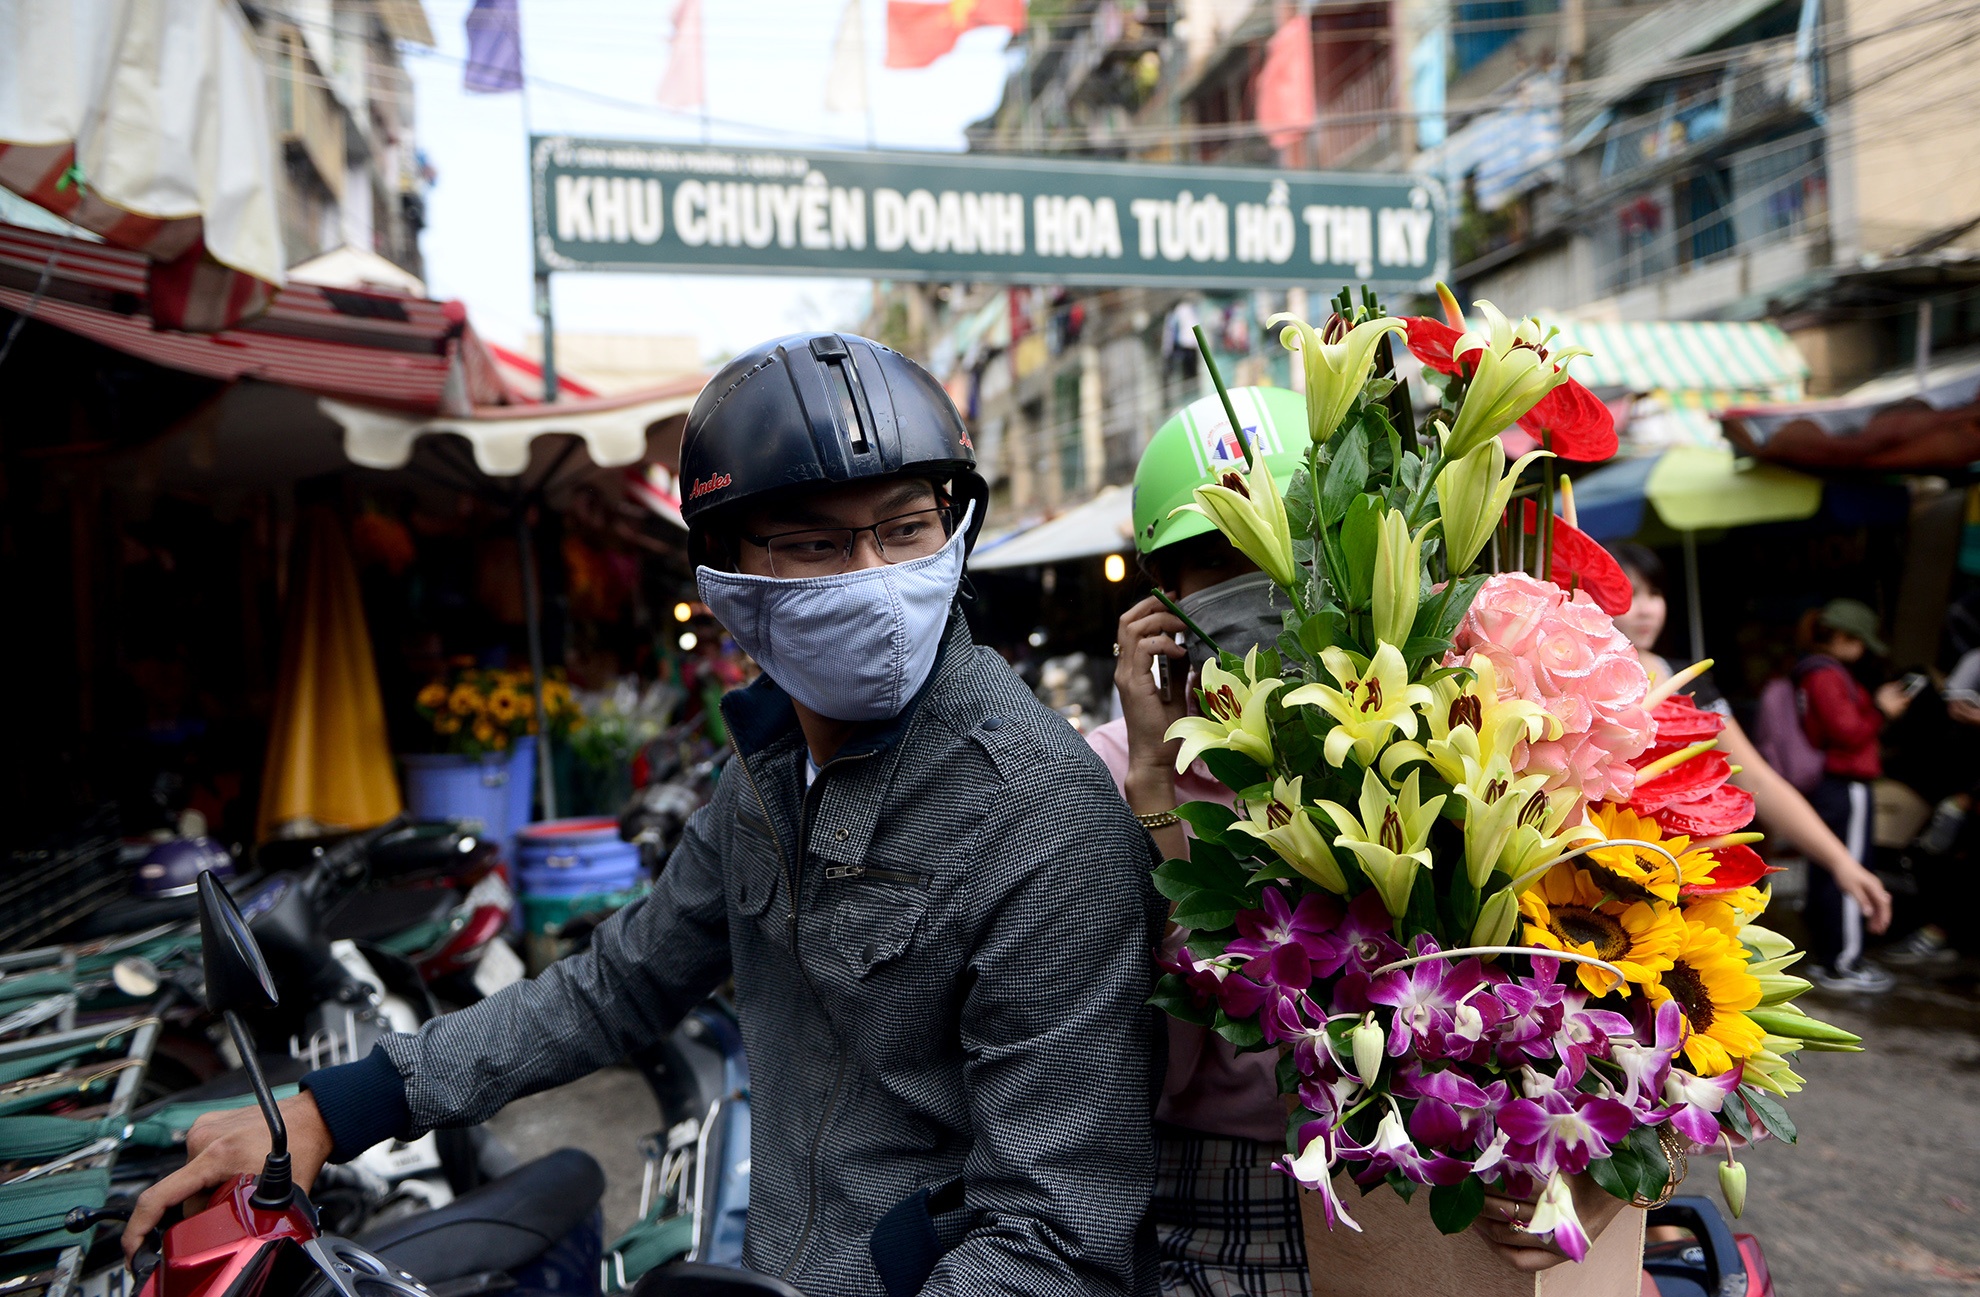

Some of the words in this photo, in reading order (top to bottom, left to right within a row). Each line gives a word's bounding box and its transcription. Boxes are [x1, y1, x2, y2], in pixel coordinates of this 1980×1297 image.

[555, 174, 664, 245] KHU
[673, 170, 867, 250] CHUYÊN
[873, 187, 1026, 255] DOANH
[1033, 194, 1123, 259] HOA
[1130, 190, 1229, 262] TƯƠI
[1303, 204, 1373, 279] THỊ
[689, 472, 732, 500] Andes
